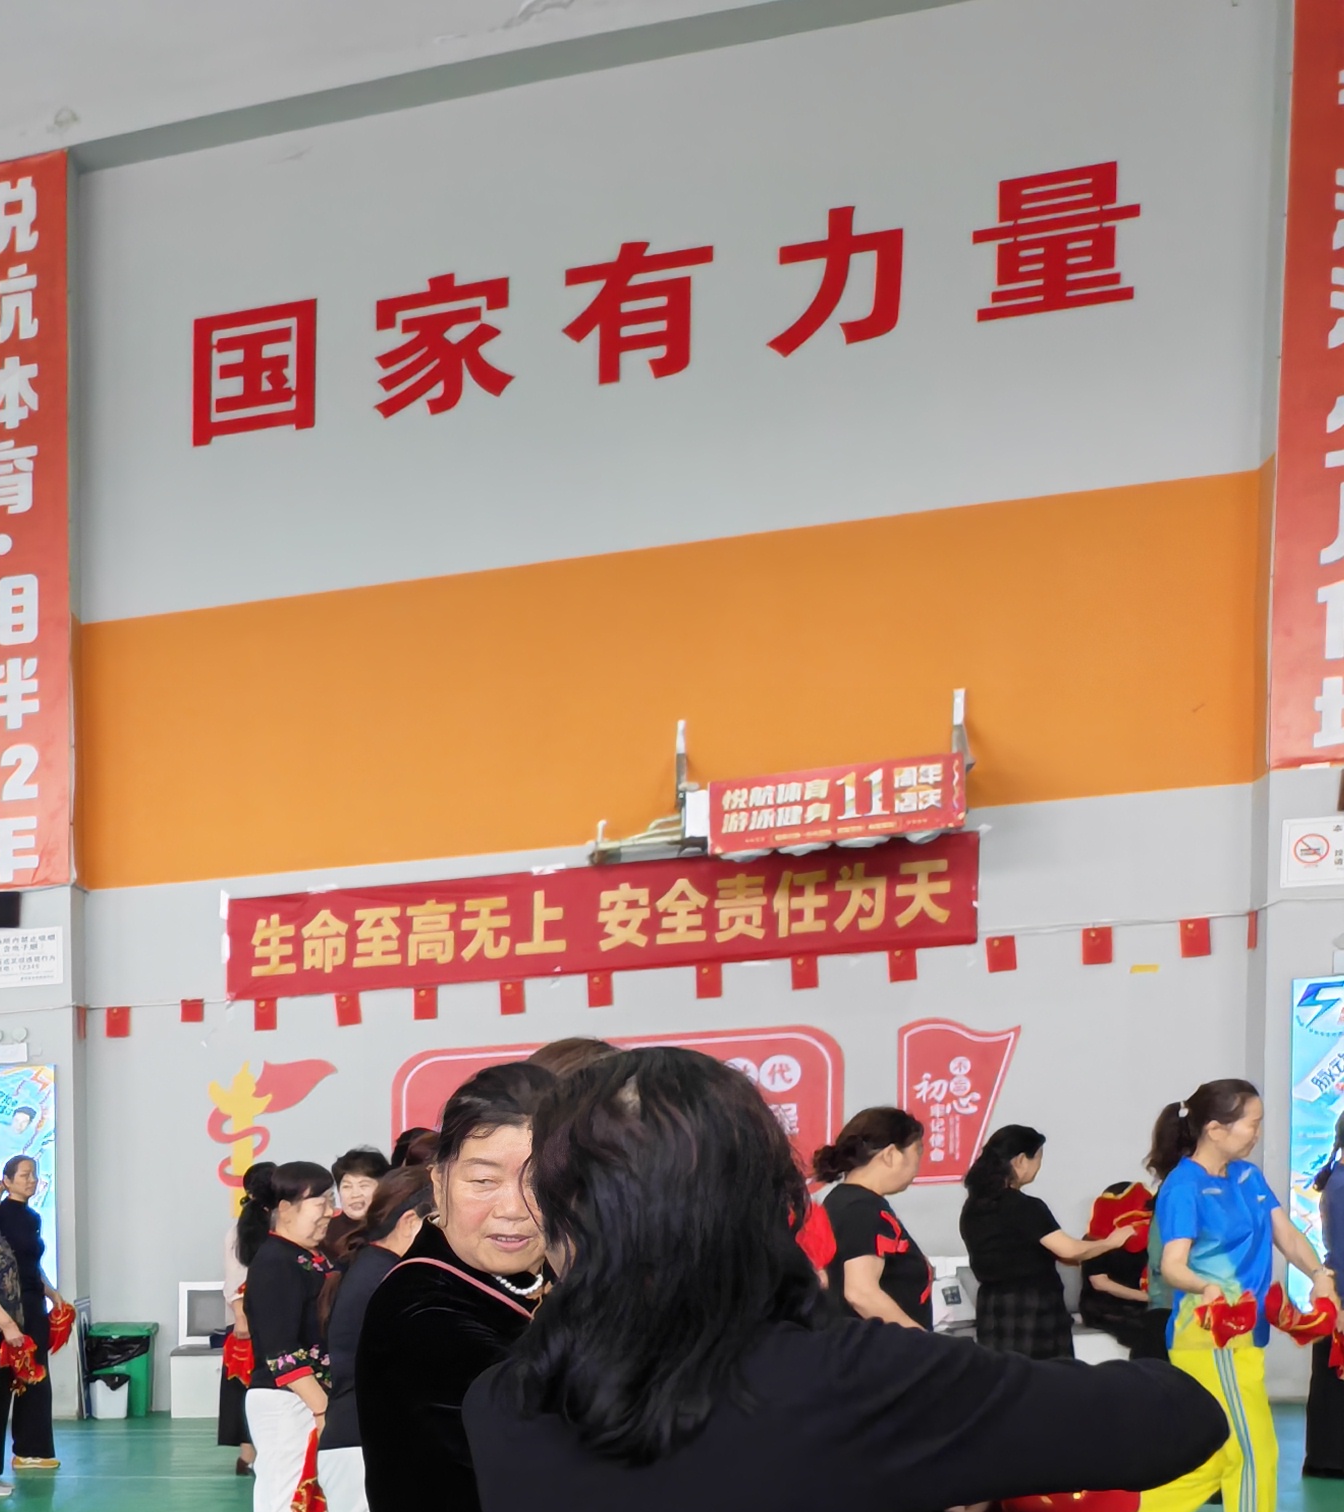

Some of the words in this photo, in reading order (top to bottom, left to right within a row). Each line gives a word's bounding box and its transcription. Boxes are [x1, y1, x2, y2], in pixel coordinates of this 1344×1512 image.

[193, 161, 1141, 447] 国家有力量
[722, 779, 830, 811] 悦航体育
[836, 767, 890, 820] 11
[894, 763, 943, 788] 周年
[722, 803, 831, 833] 游泳健身
[251, 890, 566, 978] 生命至高无上
[597, 859, 952, 951] 安全责任为天
[913, 1072, 981, 1115] 初心
